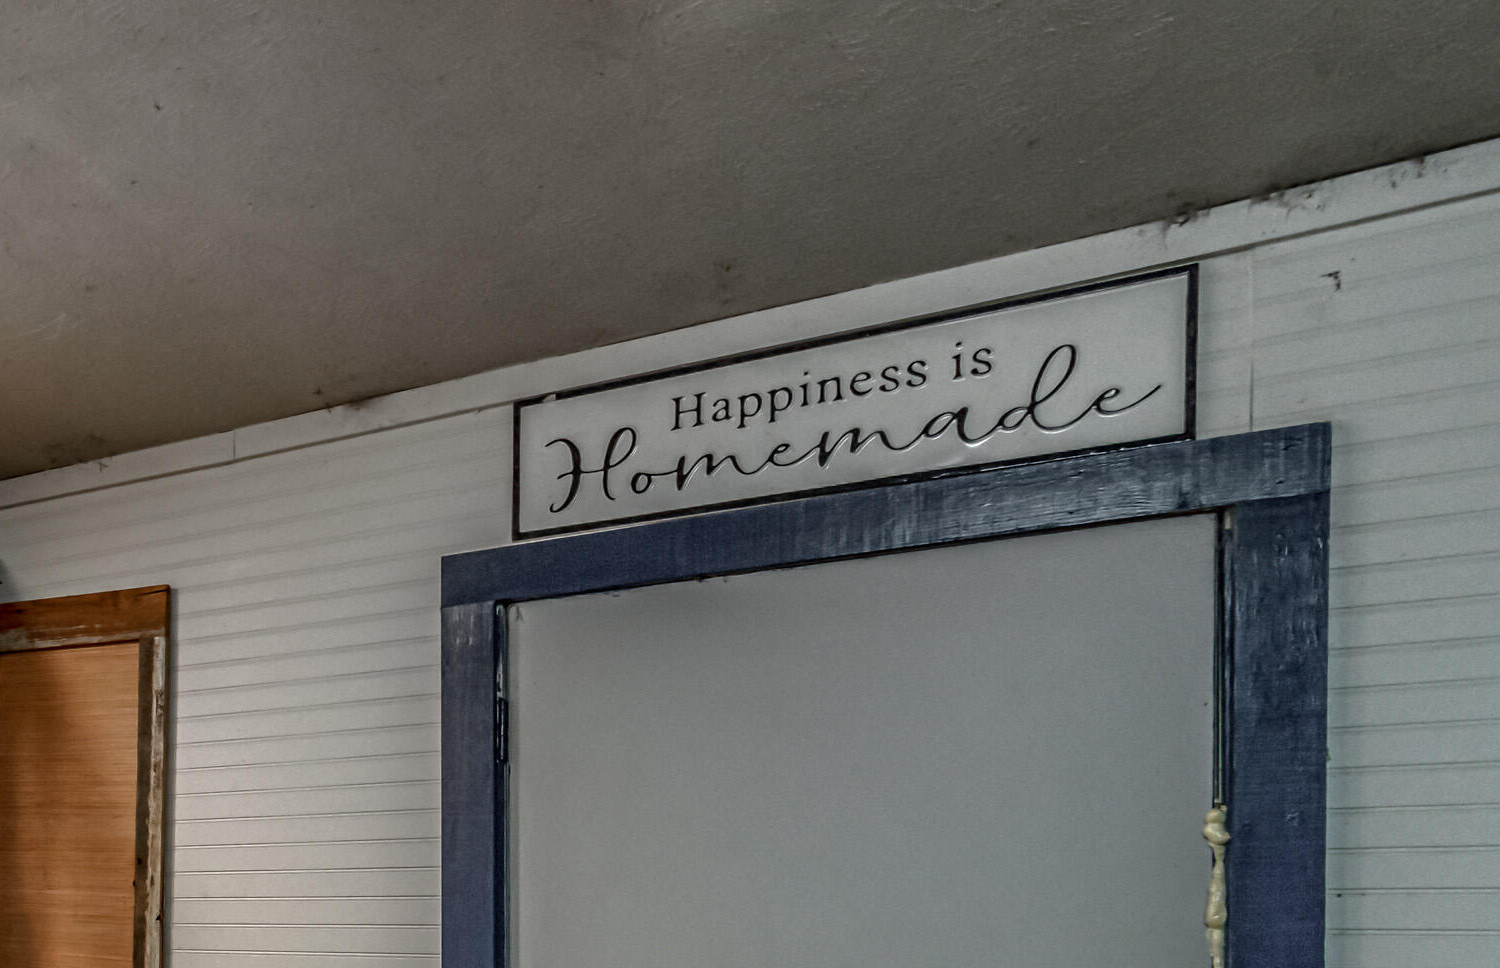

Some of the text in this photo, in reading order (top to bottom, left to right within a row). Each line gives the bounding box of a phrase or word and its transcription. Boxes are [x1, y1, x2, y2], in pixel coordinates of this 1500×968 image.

[544, 344, 1162, 513] Homemade
[670, 341, 994, 431] Happiness is
